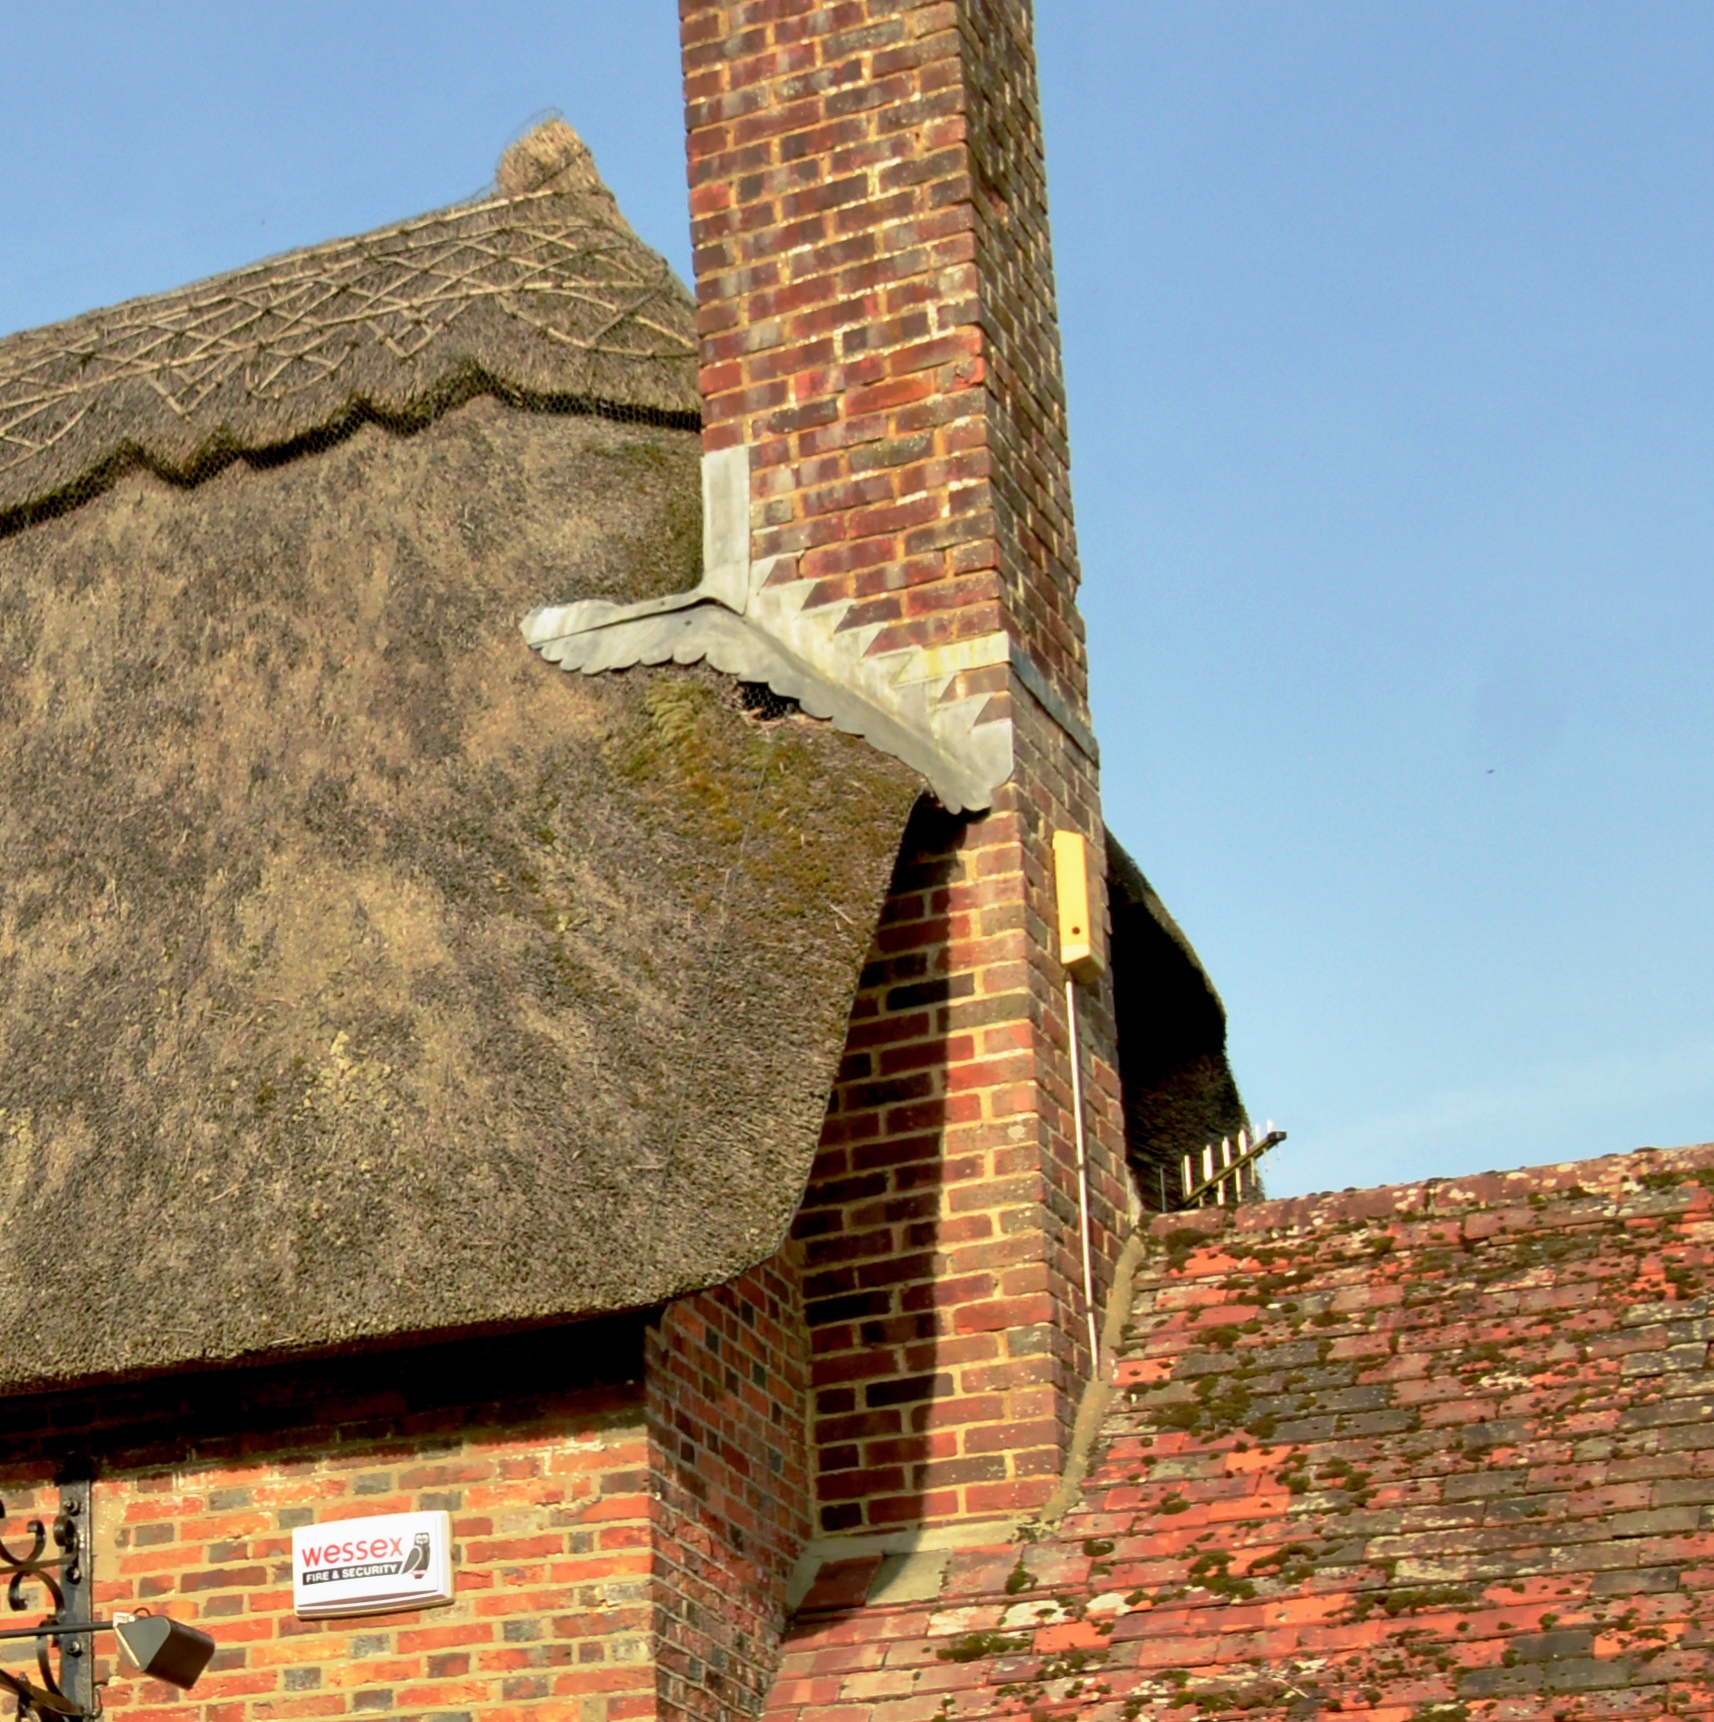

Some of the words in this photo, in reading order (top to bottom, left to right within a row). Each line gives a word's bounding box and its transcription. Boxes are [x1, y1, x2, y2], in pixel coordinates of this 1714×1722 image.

[302, 1537, 403, 1567] wessex
[306, 1572, 330, 1584] FIRE
[332, 1569, 340, 1579] &
[342, 1564, 398, 1578] SECURITY
